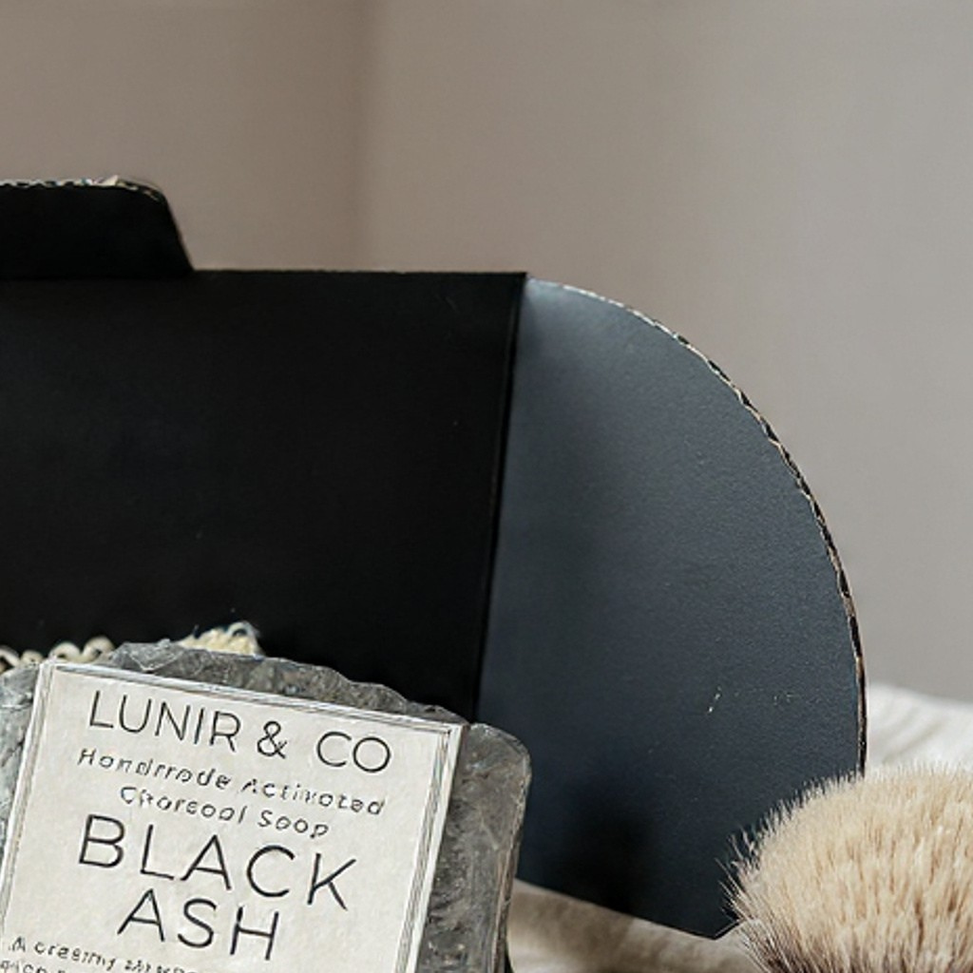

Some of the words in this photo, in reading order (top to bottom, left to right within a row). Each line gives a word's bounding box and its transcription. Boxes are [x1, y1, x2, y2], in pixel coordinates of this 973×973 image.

[89, 690, 241, 752] LUNIR
[256, 720, 288, 759] &
[315, 731, 392, 773] CO
[239, 777, 386, 816] Activated
[258, 809, 330, 839] Soap
[77, 813, 358, 911] BLACK
[116, 887, 281, 961] ASH
